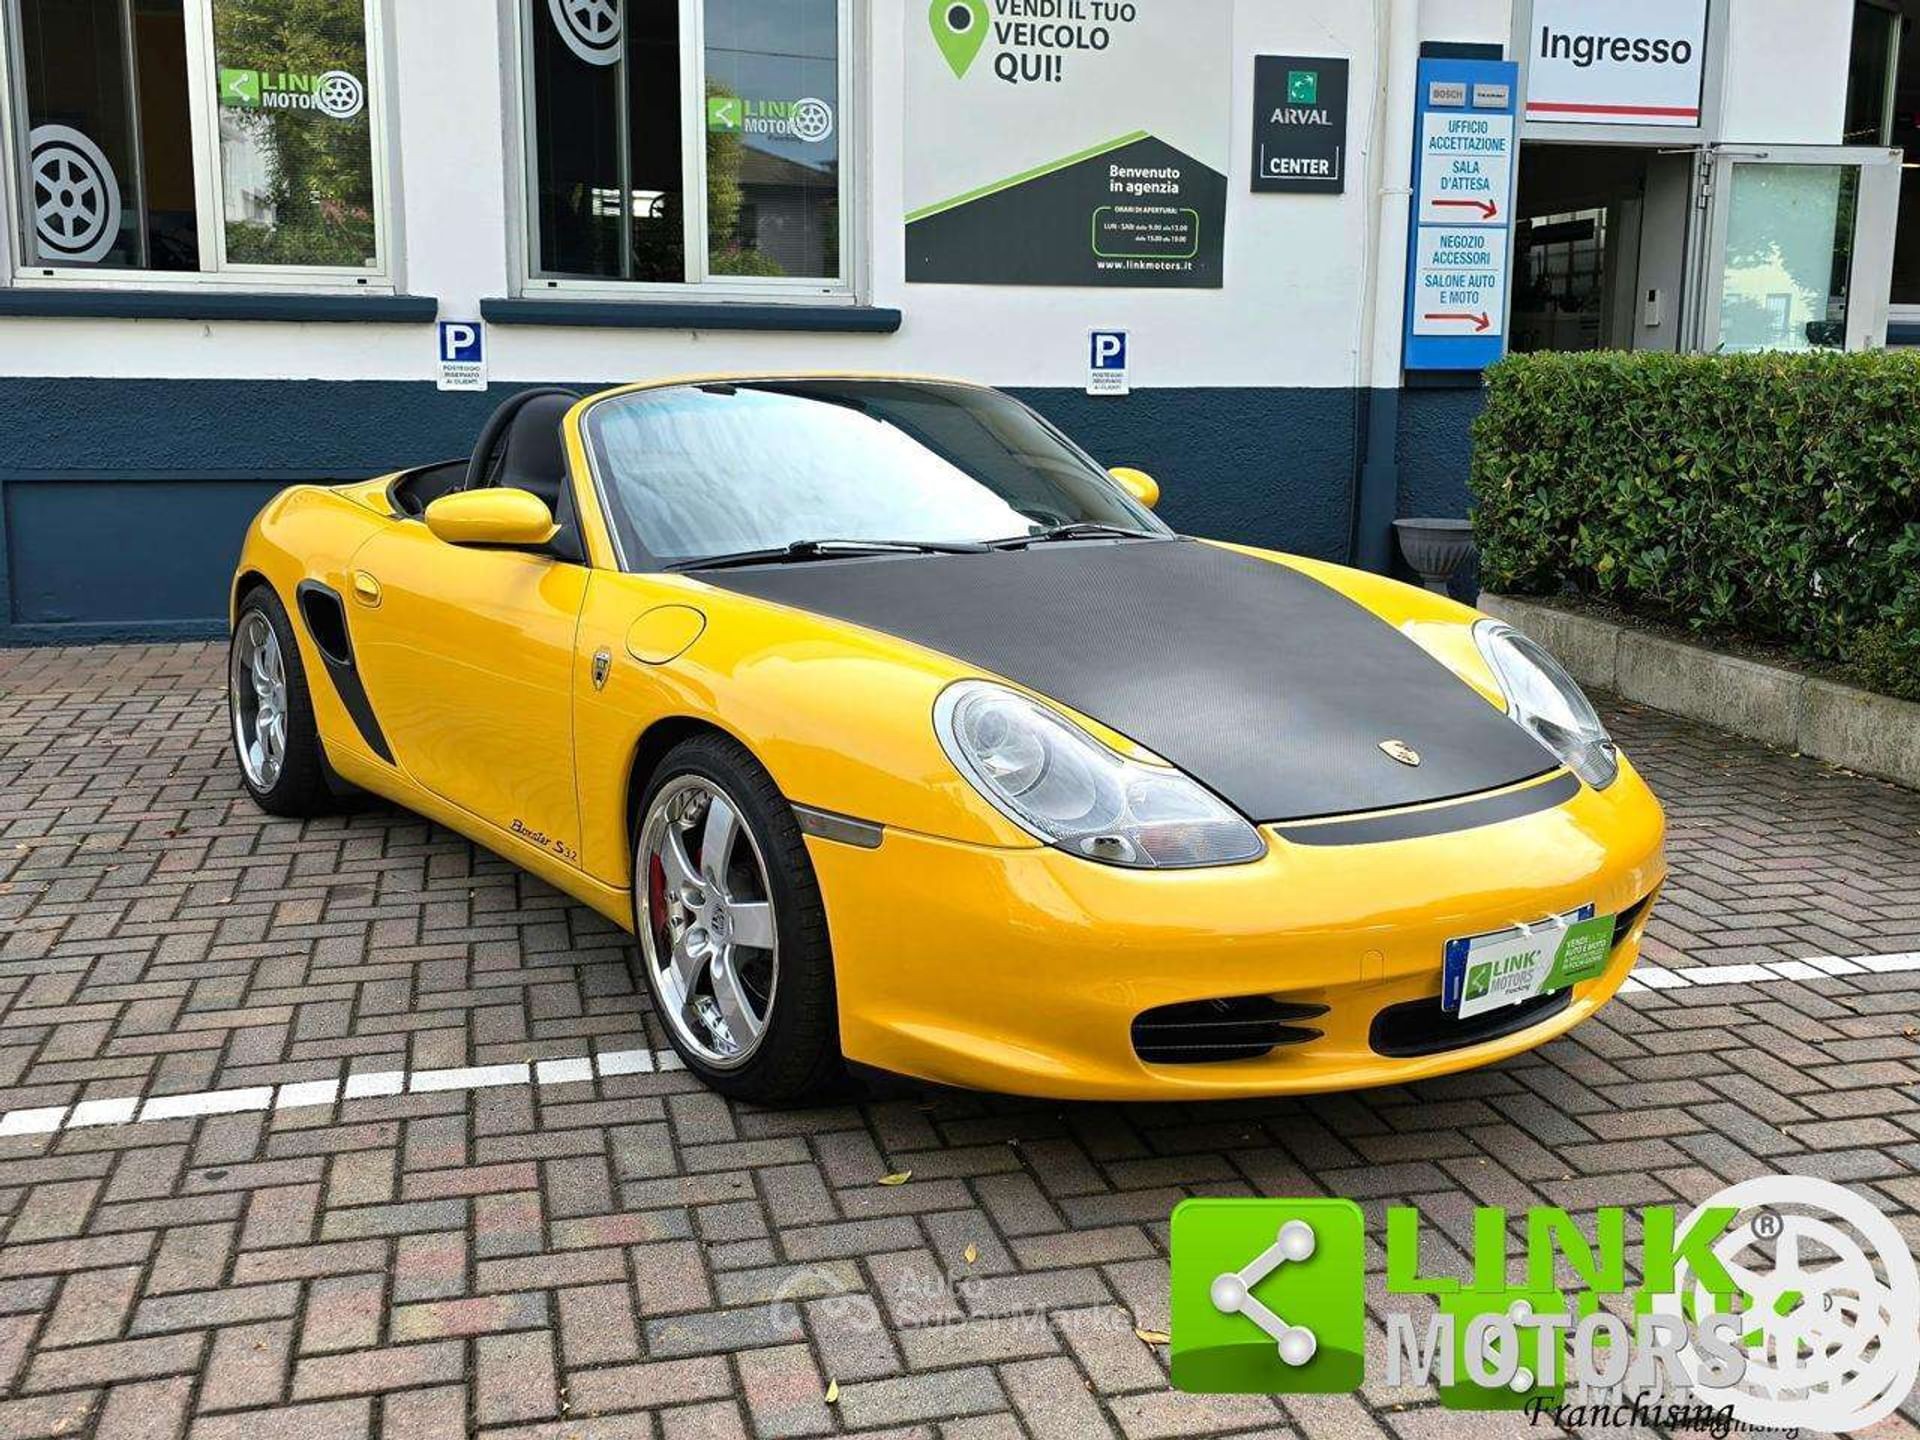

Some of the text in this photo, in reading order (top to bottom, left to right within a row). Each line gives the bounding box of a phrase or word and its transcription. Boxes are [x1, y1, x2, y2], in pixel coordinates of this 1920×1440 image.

[995, 0, 1136, 22] VENDI IL TUO
[994, 22, 1110, 50] VEICOLO
[1540, 26, 1692, 67] Ingresso
[994, 52, 1063, 84] QUI!
[1434, 89, 1463, 100] BOSCH
[1270, 108, 1333, 126] ARVAL
[1449, 120, 1488, 134] UFFICIO
[1429, 136, 1506, 151] ACCETTAZIONE
[1110, 165, 1180, 179] Benvenuto
[1270, 158, 1329, 174] CENTER
[1452, 160, 1480, 174] SALA
[1110, 179, 1180, 196] in agenzia
[1441, 177, 1490, 190] D'ATTESA
[1440, 235, 1485, 248] NEGOZIO
[1097, 260, 1193, 270] www.linkmotors.it
[1432, 252, 1490, 265] ACCESSORI
[1425, 274, 1496, 287] SALONE AUTO
[1440, 291, 1479, 304] E MOTO
[446, 324, 475, 359] P
[1096, 335, 1120, 367] P
[1492, 950, 1536, 976] LINK
[1491, 969, 1534, 992] MOTORS
